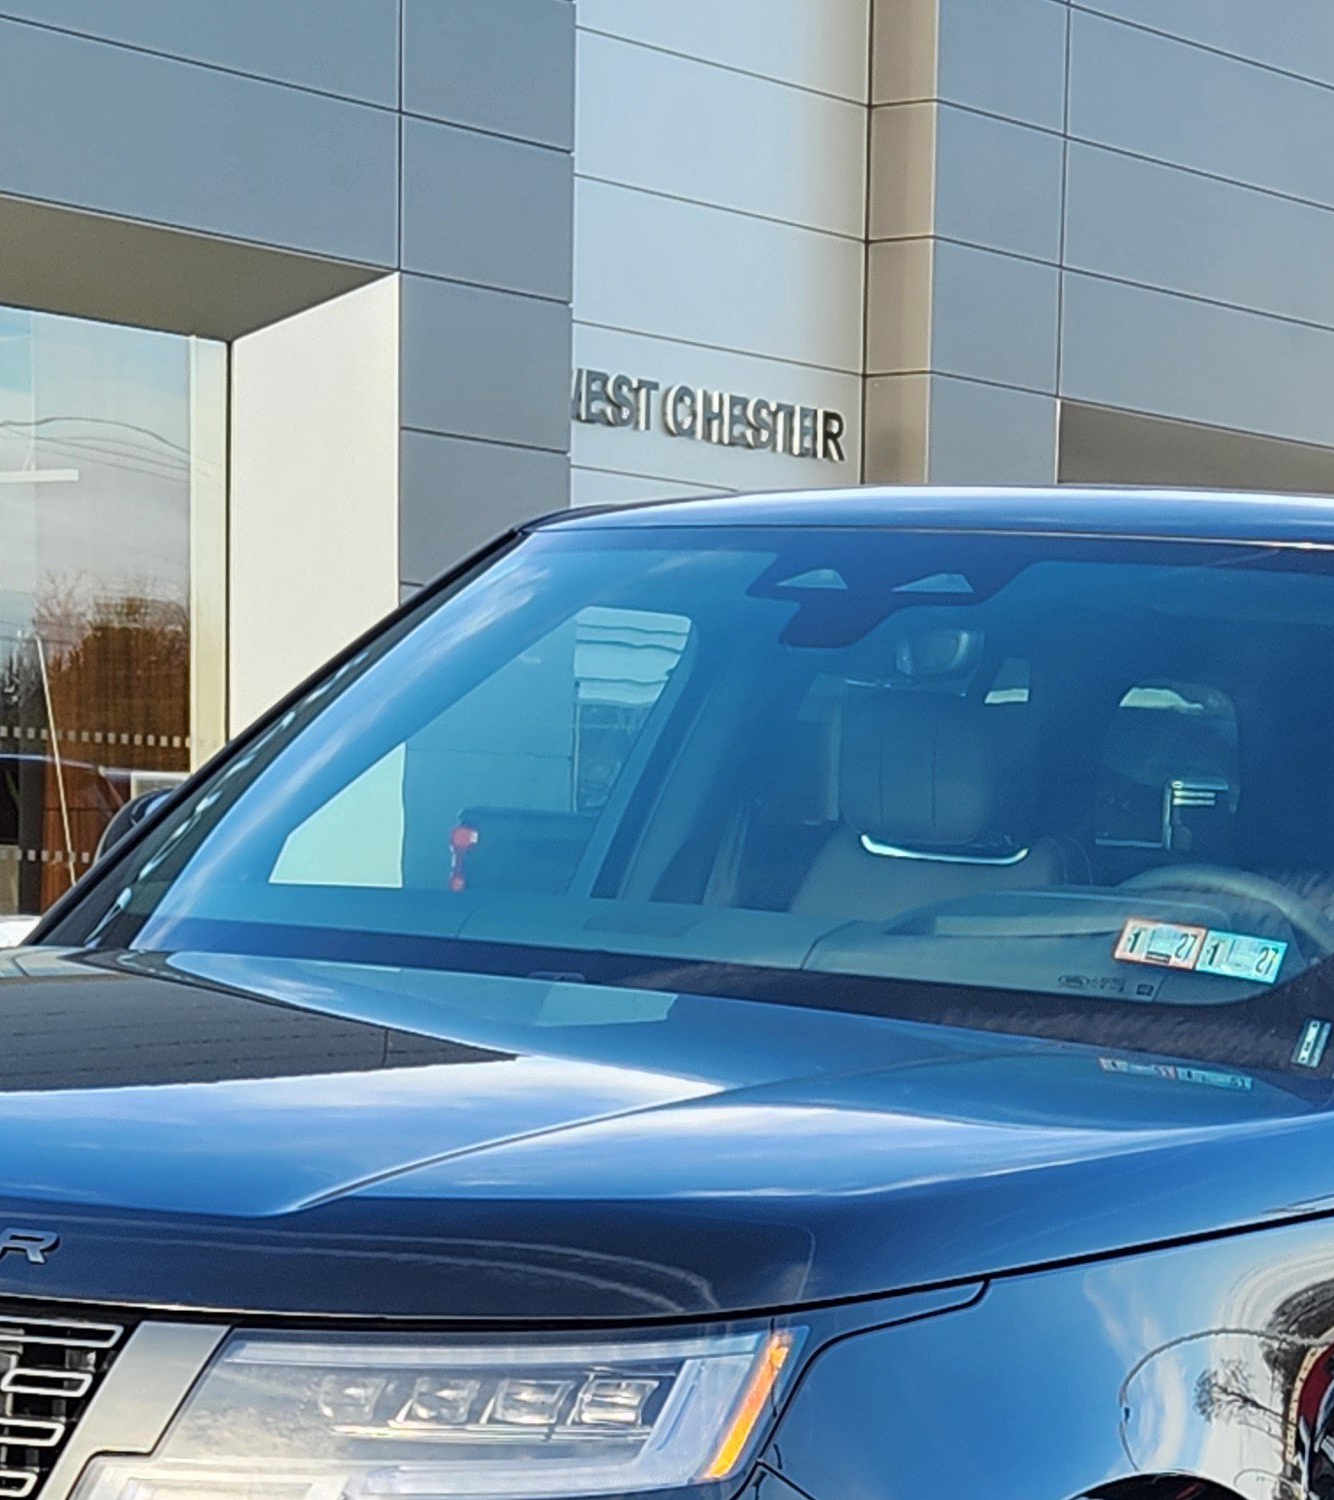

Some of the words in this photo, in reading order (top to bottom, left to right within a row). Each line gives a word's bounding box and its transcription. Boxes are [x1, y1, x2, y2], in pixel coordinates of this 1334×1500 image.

[572, 368, 659, 431] EST
[663, 384, 845, 461] CHESTER
[1174, 933, 1199, 962] 27
[1255, 946, 1280, 975] 27
